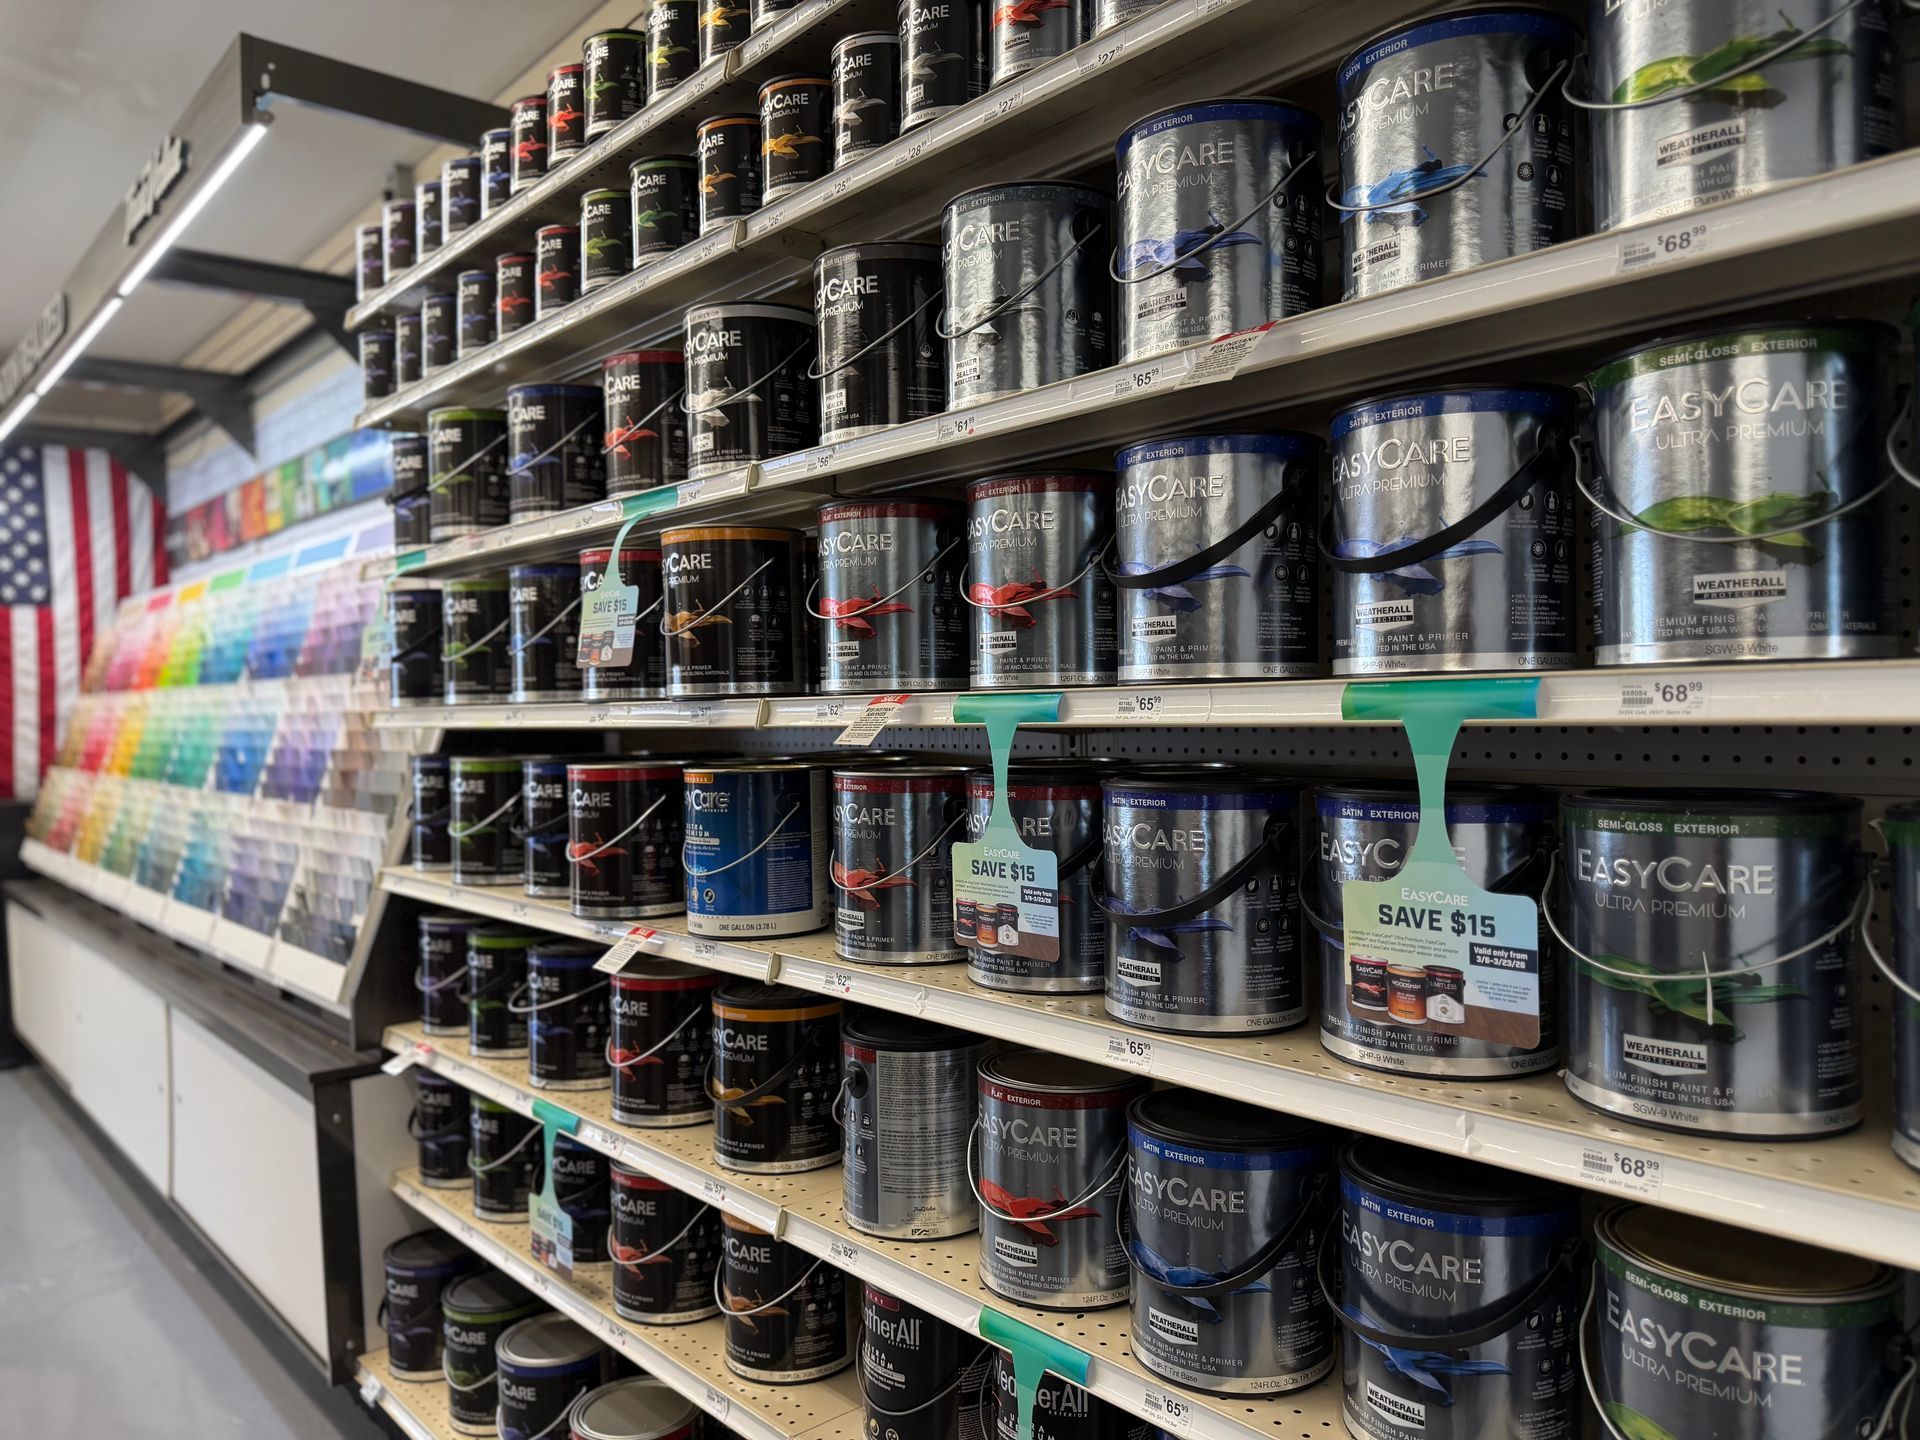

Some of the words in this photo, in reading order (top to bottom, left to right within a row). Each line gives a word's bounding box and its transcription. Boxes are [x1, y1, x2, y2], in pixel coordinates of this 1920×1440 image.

[1365, 39, 1408, 65] EXTERIOR
[1153, 114, 1193, 133] EXTERIOR
[1658, 123, 1743, 155] WEATHERALL
[1152, 174, 1213, 199] PREMIUM
[1353, 241, 1399, 266] WEATHERALL
[1415, 259, 1451, 276] PRIMER
[825, 300, 863, 319] PREMIUM
[1138, 293, 1186, 311] WEATHERALL
[1659, 345, 1739, 367] SEMI-GLOSS
[1751, 338, 1817, 352] EXTERIOR
[1374, 405, 1422, 421] EXTERIOR
[1655, 426, 1719, 450] ULTRA
[1726, 420, 1824, 441] PREMIUM
[1146, 447, 1184, 459] EXTERIOR
[1373, 472, 1446, 493] PREMIUM
[835, 511, 861, 519] EXTERIOR
[1144, 506, 1202, 521] PREMIUM
[835, 556, 877, 568] PREMIUM
[1697, 577, 1784, 591] WEATHERALL
[593, 598, 611, 614] SAVE
[613, 598, 627, 613] $15
[1356, 603, 1412, 617] WEATHERALL
[1388, 634, 1415, 643] PAINT
[1155, 645, 1175, 653] PAINT
[1704, 644, 1745, 655] SGW-9
[1746, 643, 1778, 653] White
[1517, 656, 1533, 666] ONE
[1130, 798, 1166, 807] EXTERIOR
[1341, 808, 1363, 818] SATIN
[1370, 810, 1419, 820] EXTERIOR
[1597, 819, 1663, 832] SEMI-GLOSS
[1674, 824, 1740, 835] EXTERIOR
[971, 859, 1006, 879] SAVE
[1011, 862, 1035, 882] $15
[1130, 856, 1184, 870] PREMIUM
[1595, 892, 1646, 913] ULTRA
[1652, 899, 1746, 920] PREMIUM
[1378, 904, 1443, 932] SAVE
[1450, 909, 1496, 938] $15
[1474, 946, 1491, 955] Valid
[1493, 949, 1510, 958] only
[1510, 951, 1528, 960] from
[1118, 961, 1160, 975] WEATHERALL
[1430, 981, 1457, 991] LIMITLESS
[1172, 994, 1205, 1005] PRIMER
[1355, 1024, 1383, 1037] FINISH
[1385, 1030, 1413, 1041] PAINT
[1417, 1043, 1435, 1052] USA
[1626, 1039, 1705, 1061] WEATHERALL
[1383, 1056, 1405, 1066] White
[1632, 1053, 1699, 1069] PROTECTION
[1630, 1072, 1669, 1090] FINISH
[1672, 1080, 1707, 1094] PAINT
[991, 1089, 1003, 1099] FLAT
[1007, 1094, 1041, 1106] EXTERIOR
[1632, 1102, 1667, 1119] SGW-9
[1669, 1109, 1699, 1123] White
[1007, 1147, 1059, 1164] PREMIUM
[1143, 1141, 1160, 1155] SATIN
[1165, 1149, 1205, 1165] EXTERIOR
[1163, 1206, 1224, 1232] PREMIUM
[1361, 1196, 1381, 1213] SATIN
[1388, 1208, 1435, 1228] EXTERIOR
[996, 1240, 1036, 1257] WEATHERALL
[1018, 1268, 1039, 1280] PAINT
[1385, 1272, 1457, 1303] PREMIUM
[1625, 1270, 1688, 1305] SEMI-GLOSS
[1699, 1299, 1766, 1321] EXTERIOR
[1150, 1312, 1197, 1335] WEATHERALL
[1152, 1338, 1174, 1353] FINISH
[1176, 1348, 1199, 1361] PAINT
[1210, 1357, 1243, 1366] PRIMER
[1202, 1364, 1217, 1372] USA
[1622, 1341, 1670, 1381] ULTRA
[1676, 1369, 1772, 1408] PREMIUM
[1367, 1386, 1423, 1418] WEATHERALL
[1370, 1399, 1419, 1425] PROTECTION
